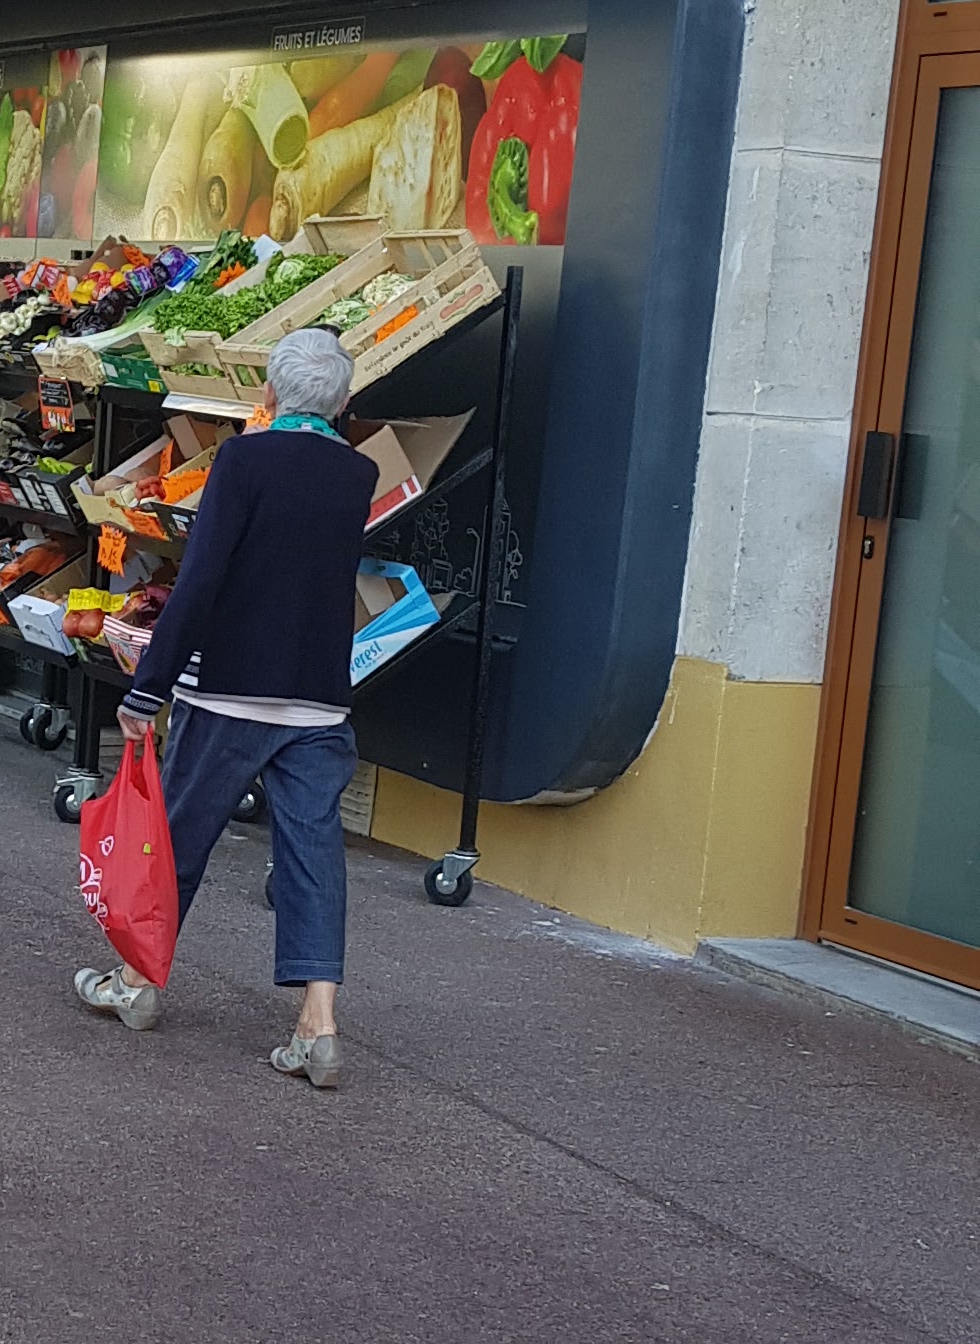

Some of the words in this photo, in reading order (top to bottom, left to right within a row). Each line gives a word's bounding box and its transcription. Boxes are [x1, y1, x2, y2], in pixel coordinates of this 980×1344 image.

[273, 33, 303, 51] FRUITS
[304, 31, 316, 49] ET
[316, 25, 362, 47] LÉGUMES
[349, 640, 383, 673] verest
